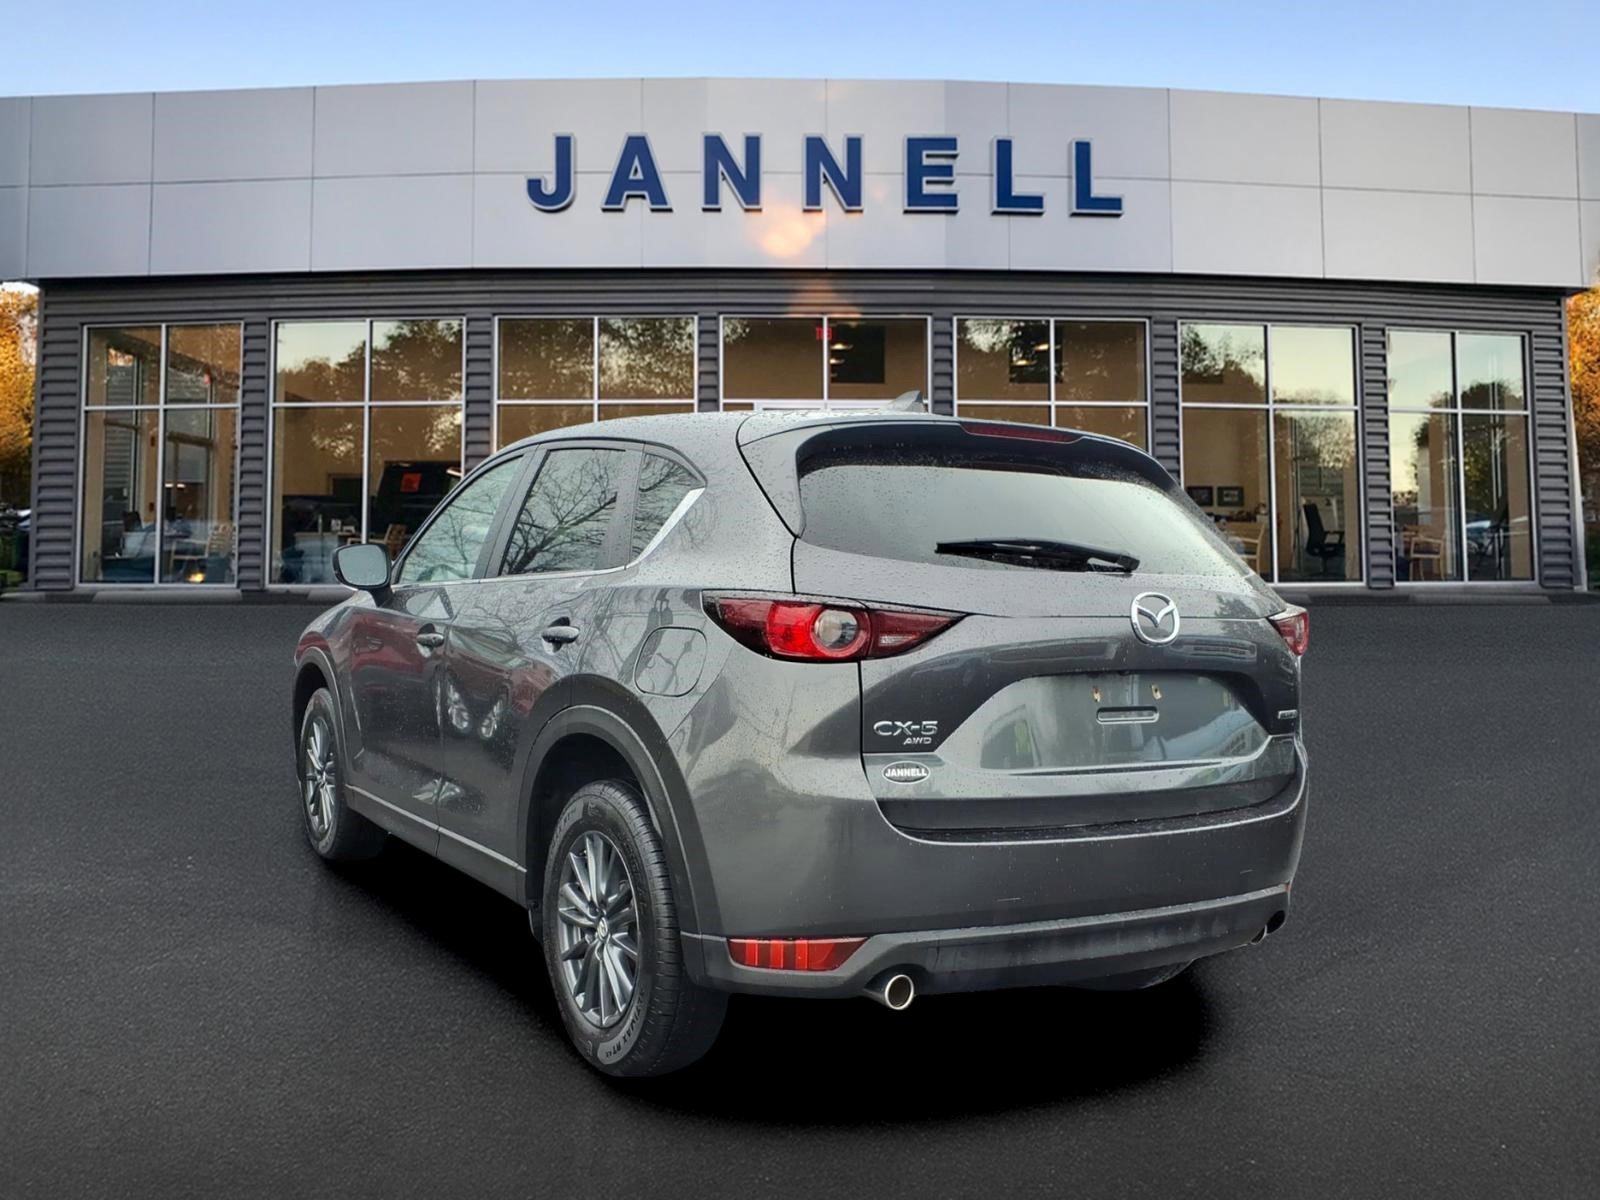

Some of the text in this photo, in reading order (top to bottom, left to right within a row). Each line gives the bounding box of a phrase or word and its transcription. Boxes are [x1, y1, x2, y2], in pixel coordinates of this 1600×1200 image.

[526, 132, 1124, 216] JANNELL
[873, 720, 938, 737] CX-5
[903, 737, 932, 745] AWD
[885, 768, 927, 777] JANNELL
